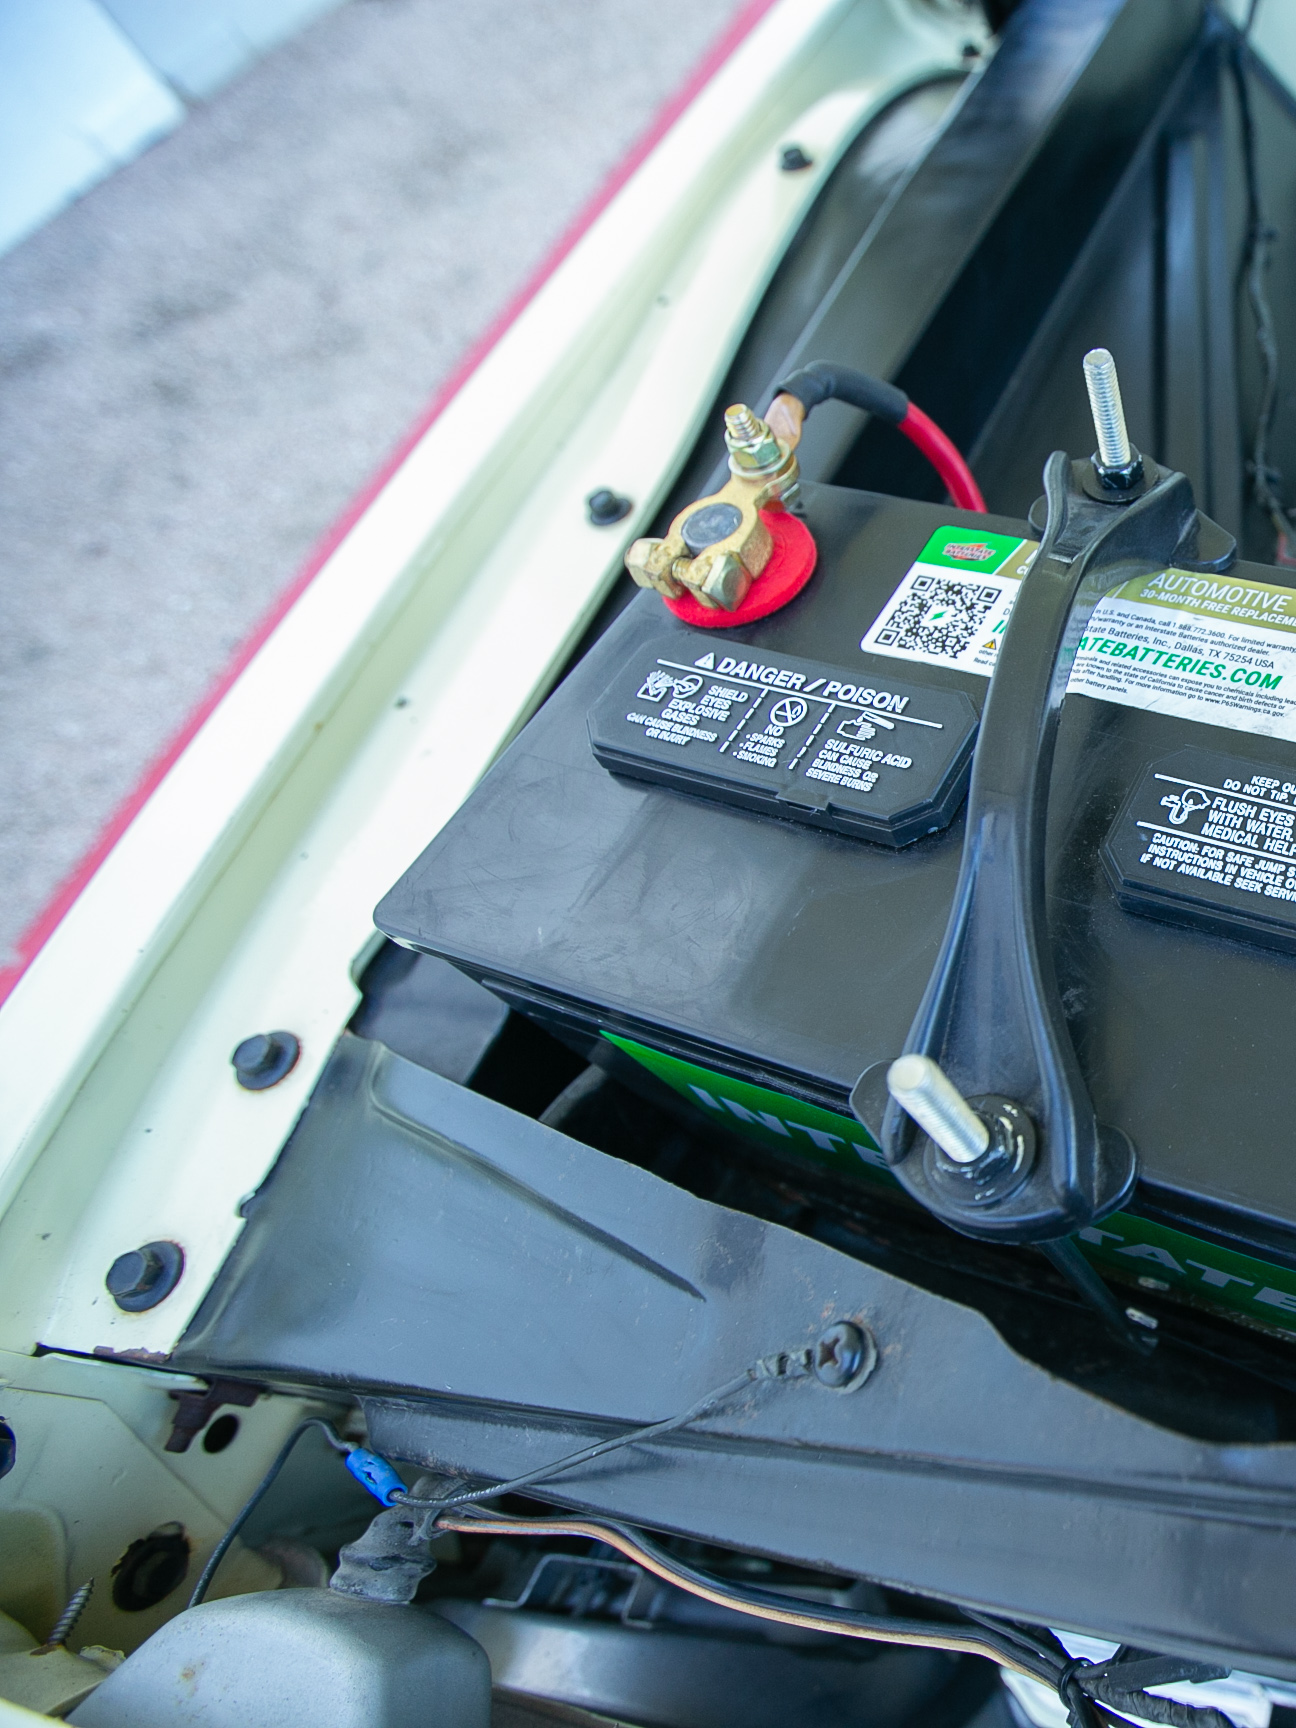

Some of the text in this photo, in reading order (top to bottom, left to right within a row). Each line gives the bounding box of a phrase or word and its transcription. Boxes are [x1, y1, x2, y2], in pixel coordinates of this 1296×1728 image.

[1140, 589, 1202, 607] 30-MONTH
[1202, 600, 1231, 614] FREE
[1148, 573, 1293, 612] AUTOMOTIVE
[1130, 614, 1156, 624] Canada,
[1241, 636, 1264, 647] limited
[1145, 625, 1177, 636] Interstate
[1178, 630, 1208, 643] Batteries
[1210, 640, 1246, 652] authorized
[1248, 646, 1270, 656] dealer.
[974, 656, 988, 666] Read
[1108, 628, 1150, 644] Batteries,
[1152, 637, 1172, 649] Inc.,
[1174, 642, 1204, 656] Dallas,
[1208, 649, 1222, 658] TX
[1223, 652, 1253, 664] 75254
[1254, 658, 1274, 669] USA
[708, 685, 748, 702] SHIELD
[716, 658, 806, 690] DANGER
[822, 681, 910, 713] POISON
[1086, 678, 1106, 689] battery
[1086, 662, 1104, 671] known
[1124, 671, 1138, 679] state
[1148, 676, 1176, 688] California
[1204, 690, 1224, 698] cancer
[1239, 696, 1253, 704] birth
[1254, 699, 1276, 709] defects
[1096, 672, 1122, 682] handling.
[1152, 684, 1186, 697] information
[1111, 662, 1132, 670] related
[1132, 666, 1168, 678] accessories
[1181, 676, 1202, 686] expose
[1204, 682, 1214, 690] you
[1224, 686, 1254, 697] chemicals
[1255, 692, 1284, 704] including
[668, 699, 730, 722] EXPLOSIVE
[700, 694, 732, 710] EYES
[626, 712, 718, 742] CAN CAUSE BLINDNESS
[661, 708, 700, 726] GASES
[645, 728, 690, 746] OR INJURY
[751, 733, 786, 748] SPARKS
[764, 724, 784, 736] NO
[737, 750, 778, 768] SMOKING
[743, 742, 779, 757] FLAMES
[818, 750, 872, 770] CAN CAUSE
[824, 738, 912, 769] SULFURIC ACID
[806, 768, 874, 792] SEVERE BURNS
[812, 758, 879, 783] BLINDNESS OR
[1251, 776, 1280, 789] KEEP
[1224, 779, 1241, 790] DO
[1243, 784, 1267, 796] NOT
[1270, 789, 1289, 802] TIP.
[1212, 796, 1258, 818] FLUSH
[1259, 808, 1296, 826] EYES
[1200, 823, 1259, 848] MEDICAL
[1208, 810, 1243, 828] WITH
[1246, 818, 1294, 842] WATER.
[1148, 844, 1224, 871] INSTRUCTIONS
[1224, 864, 1238, 874] IN
[1240, 867, 1284, 887] VEHICLE
[1152, 833, 1200, 854] CAUTION:
[1201, 846, 1225, 860] FOR
[1226, 852, 1254, 867] SAFE
[1255, 860, 1286, 874] JUMP
[1140, 854, 1153, 864] IF
[1152, 858, 1178, 871] NOT
[1177, 864, 1234, 886] AVAILABLE
[1234, 877, 1263, 893] SEEK
